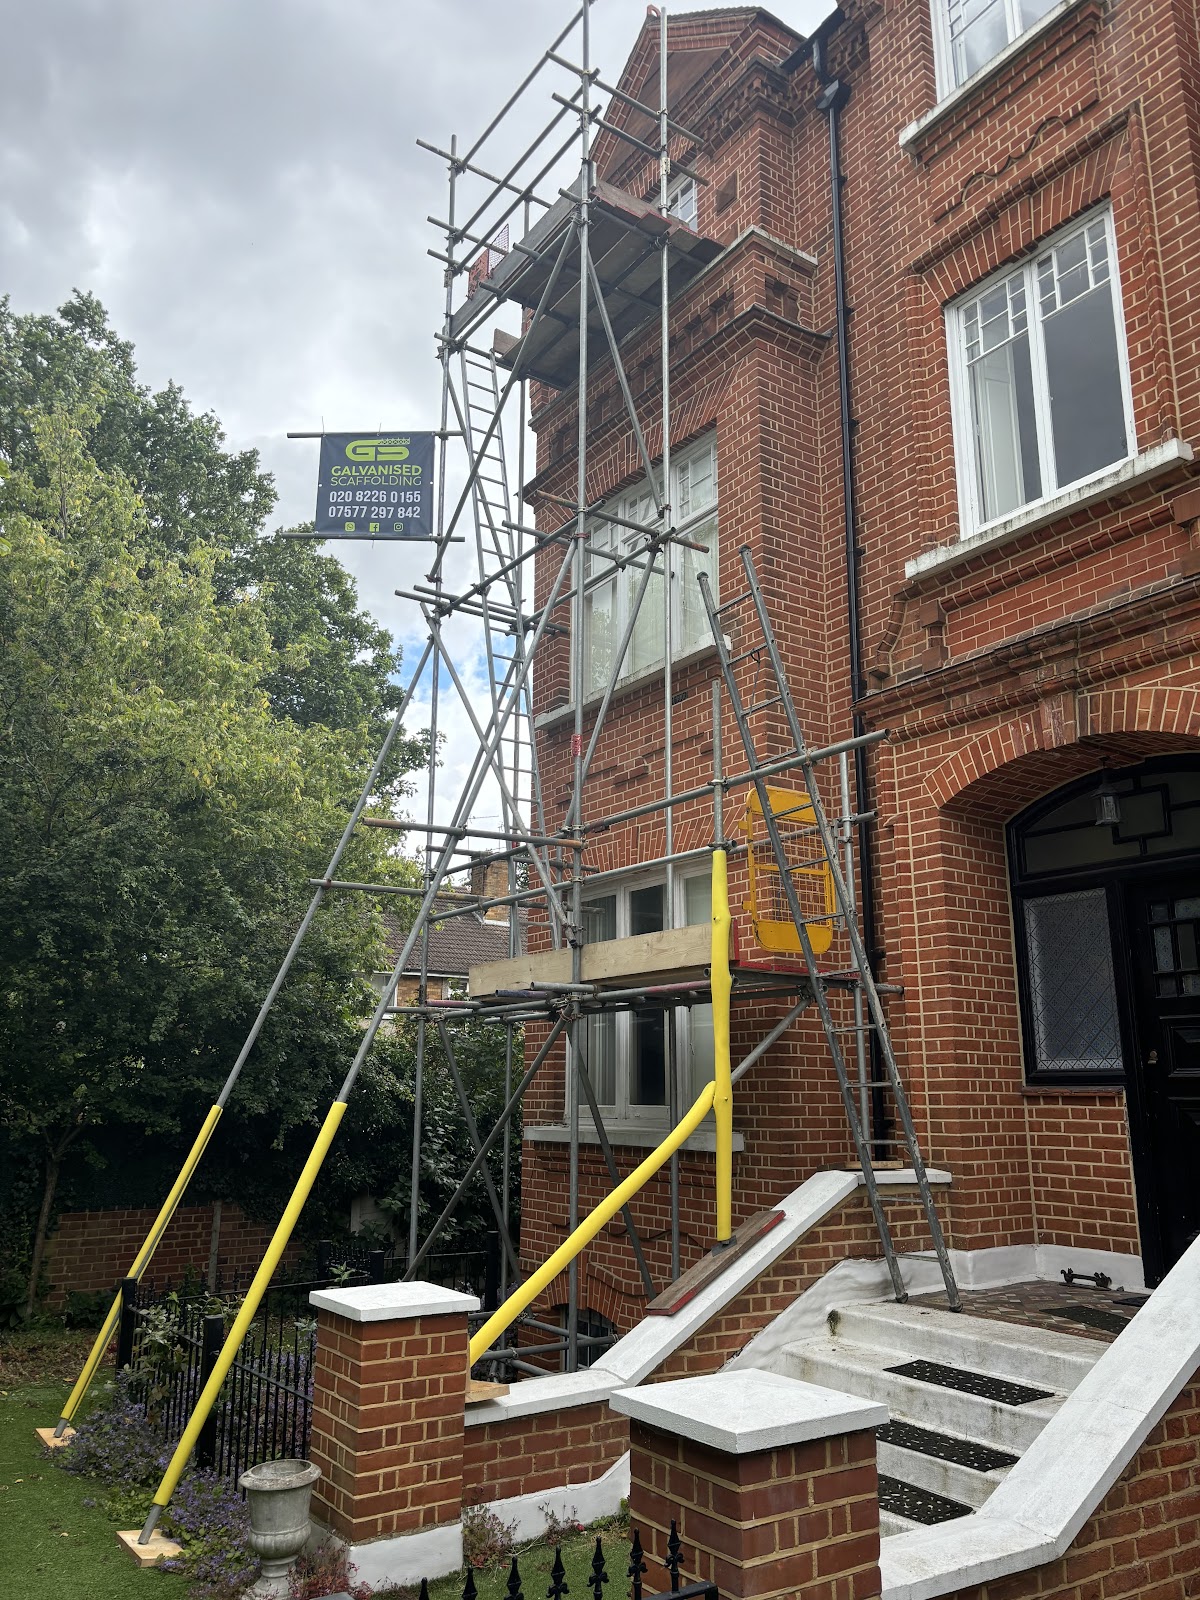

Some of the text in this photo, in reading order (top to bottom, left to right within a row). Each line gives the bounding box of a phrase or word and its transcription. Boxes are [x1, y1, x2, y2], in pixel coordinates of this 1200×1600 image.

[331, 464, 422, 476] GALVANISED
[330, 476, 422, 486] SCAFFOLDING
[329, 490, 421, 503] 020 8226 0155
[328, 505, 421, 518] 07577 297 842
